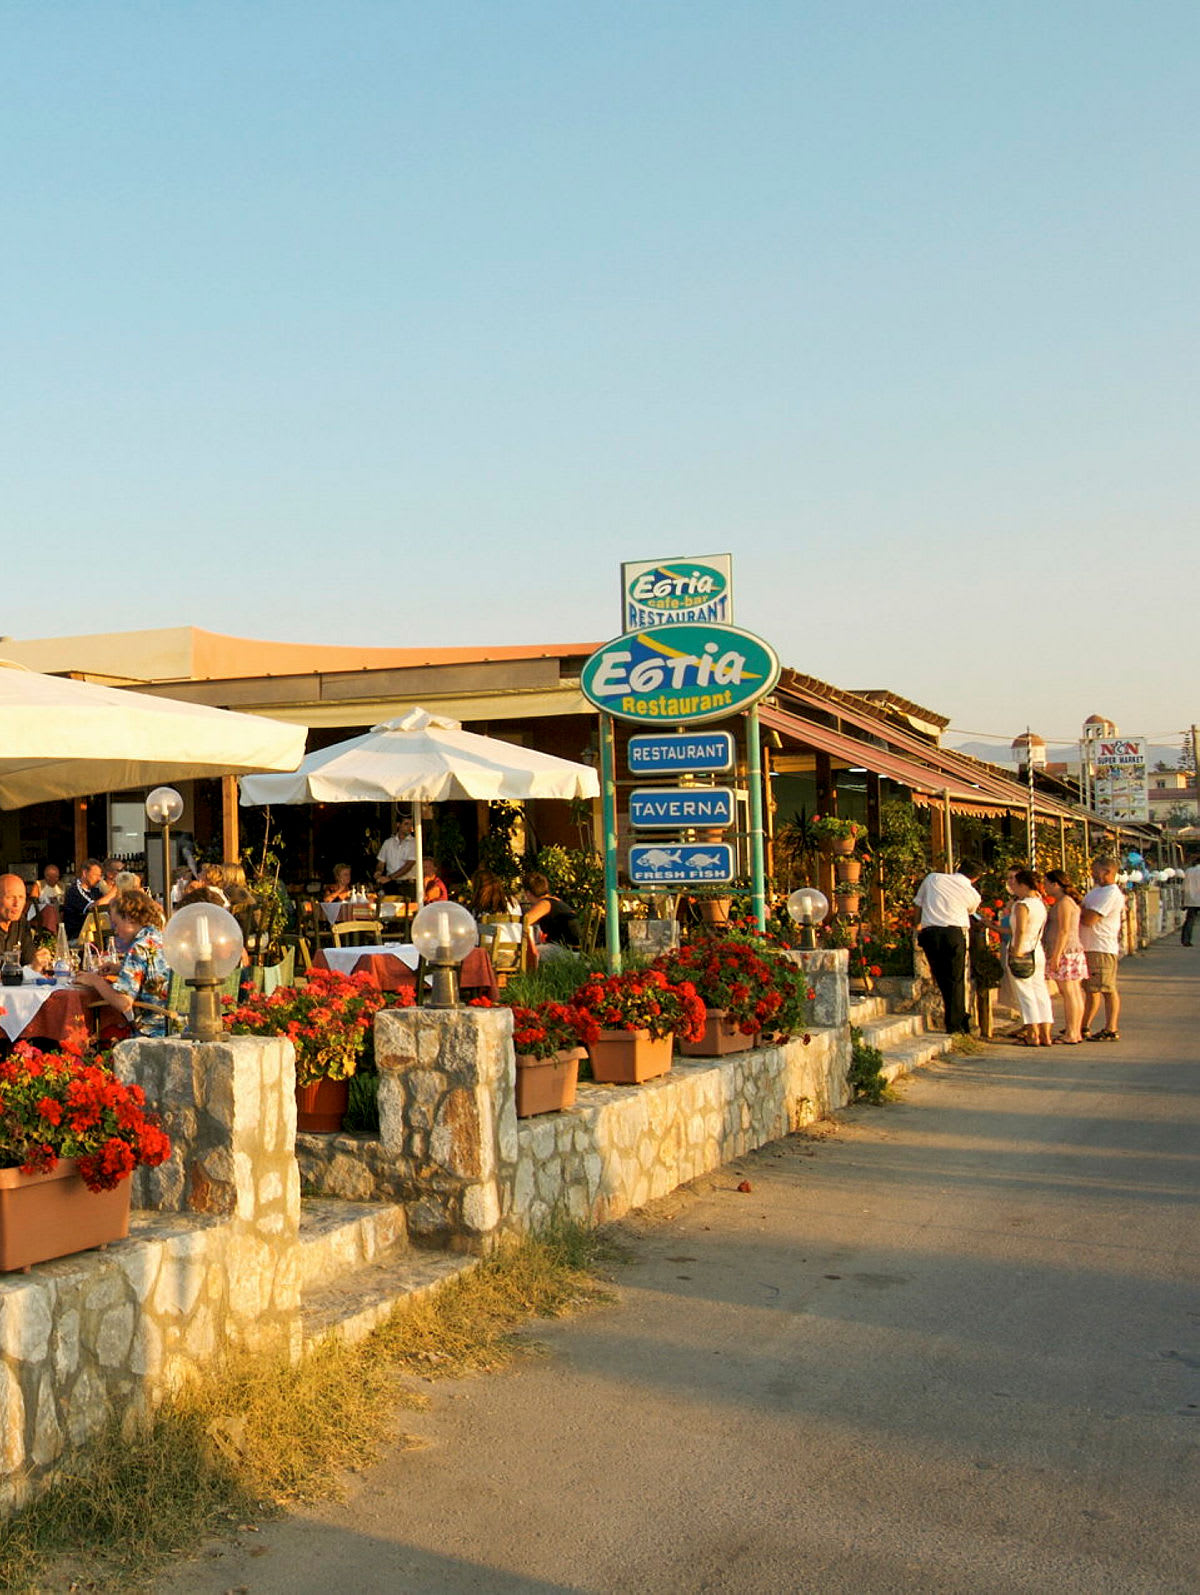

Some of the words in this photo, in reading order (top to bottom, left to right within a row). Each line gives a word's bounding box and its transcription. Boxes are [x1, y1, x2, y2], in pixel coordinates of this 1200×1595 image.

[628, 594, 728, 628] RESTAURANT
[621, 690, 732, 716] Restaurant
[632, 743, 725, 761] RESTAURANT
[1100, 740, 1140, 755] N&N
[632, 801, 728, 817] TAVERNA
[635, 871, 685, 880] FRESH
[689, 869, 726, 879] FISH
